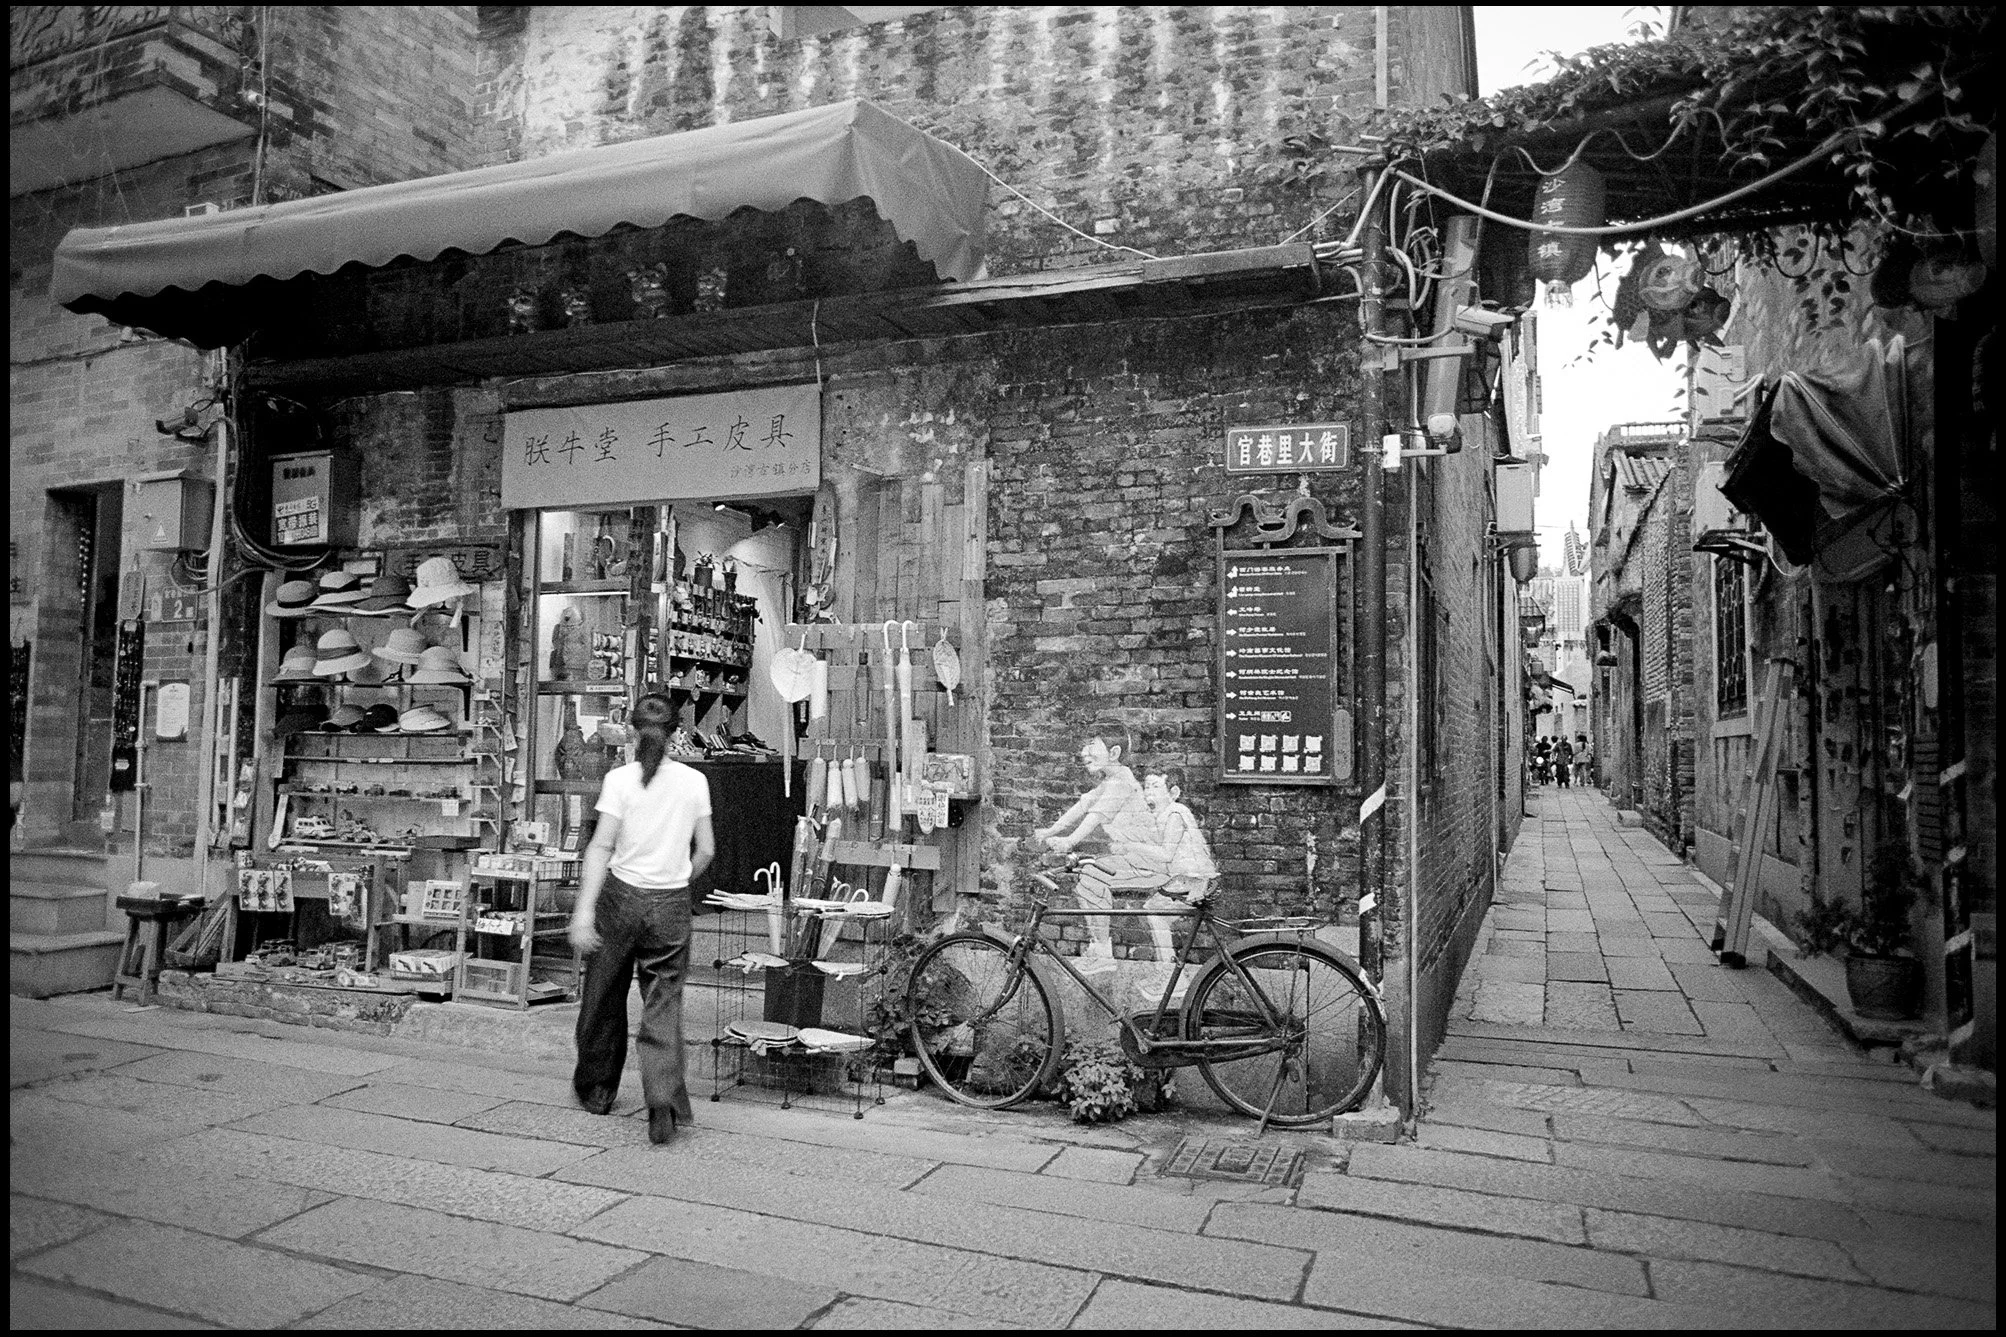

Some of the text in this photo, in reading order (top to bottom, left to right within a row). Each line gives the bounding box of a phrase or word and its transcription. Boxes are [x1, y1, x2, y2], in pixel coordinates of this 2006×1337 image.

[645, 413, 794, 458] 手工皮具
[1237, 431, 1338, 466] 官巷里大街
[404, 550, 491, 576] 手皮具
